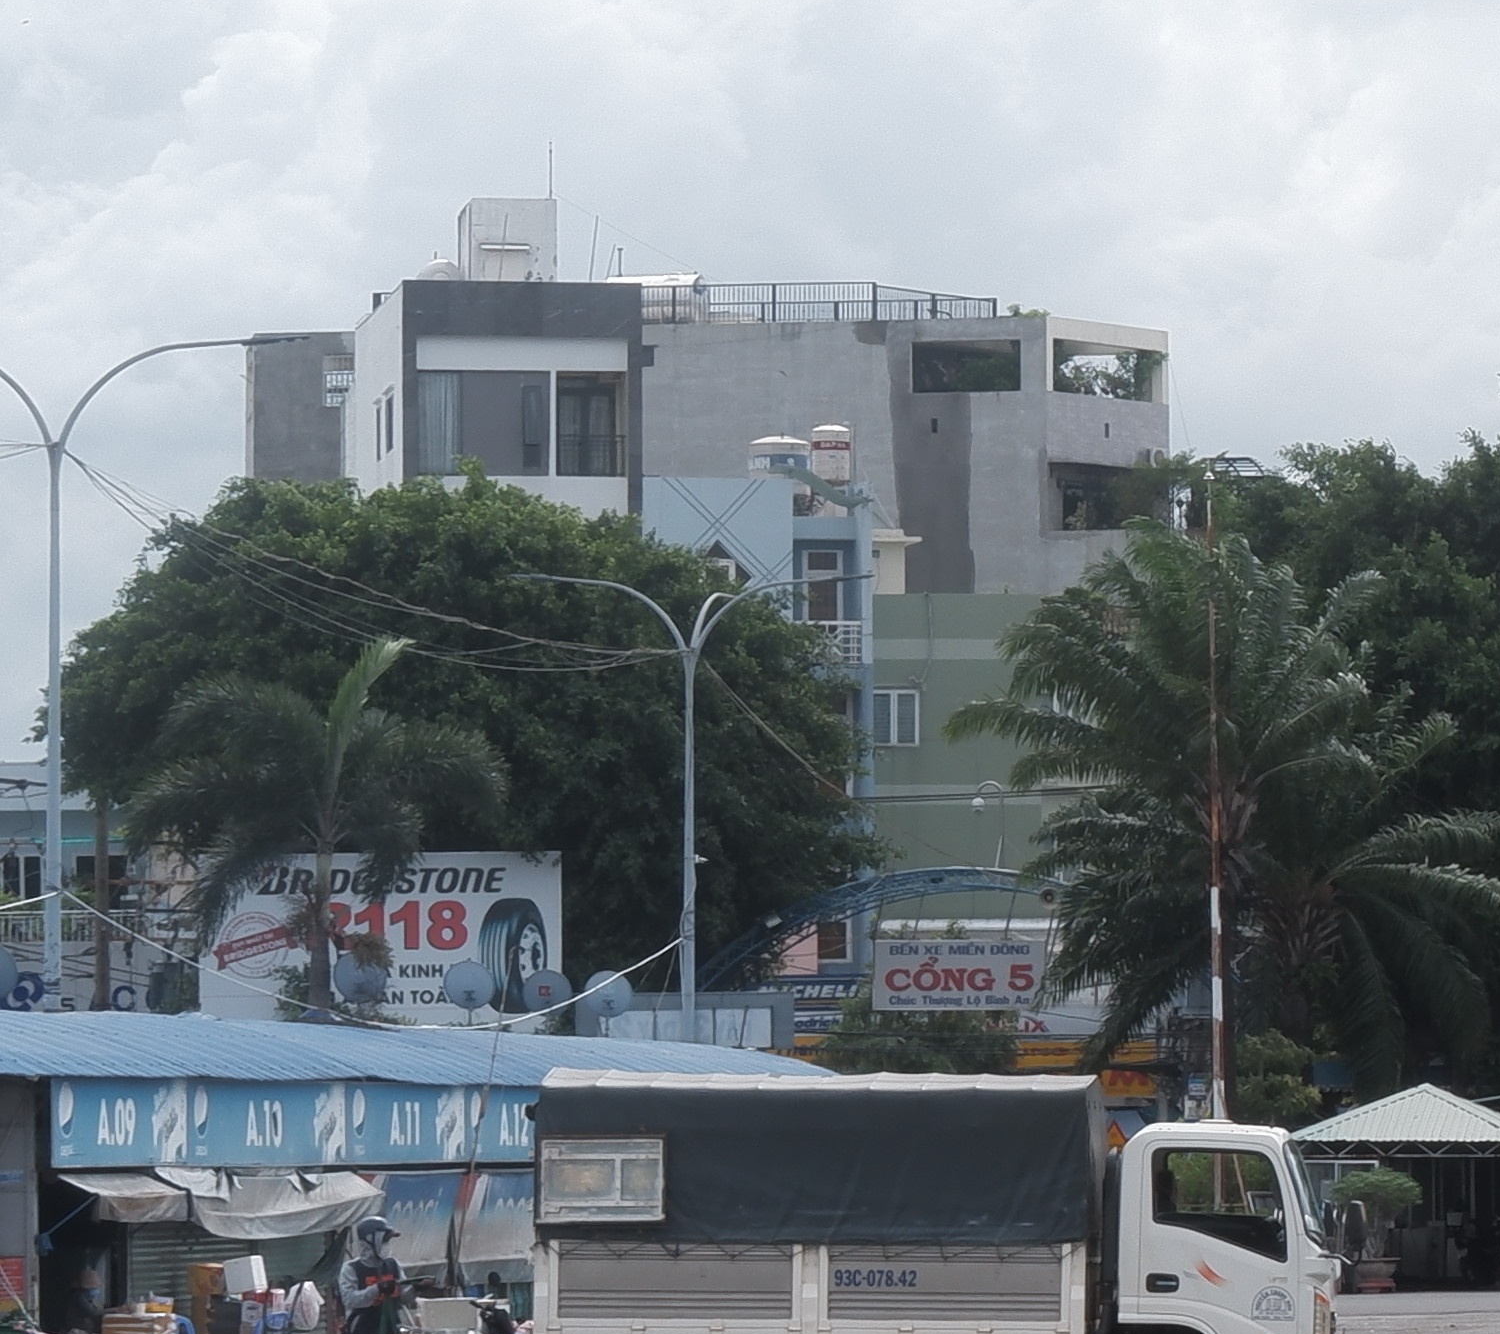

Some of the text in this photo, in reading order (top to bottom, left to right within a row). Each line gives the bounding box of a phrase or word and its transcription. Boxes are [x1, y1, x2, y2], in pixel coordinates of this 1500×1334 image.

[889, 943, 1030, 955] BẾN XE MIỀN ĐÔNG
[398, 964, 443, 978] KINH
[885, 956, 1034, 992] CỔNG 5
[409, 984, 452, 1004] TOÀ
[1014, 995, 1030, 1005] An
[97, 1097, 136, 1146] A.09
[246, 1099, 283, 1147] A.10
[390, 1101, 420, 1146] A.11
[500, 1103, 529, 1146] A.12
[834, 1269, 917, 1287] 93C-078.42
